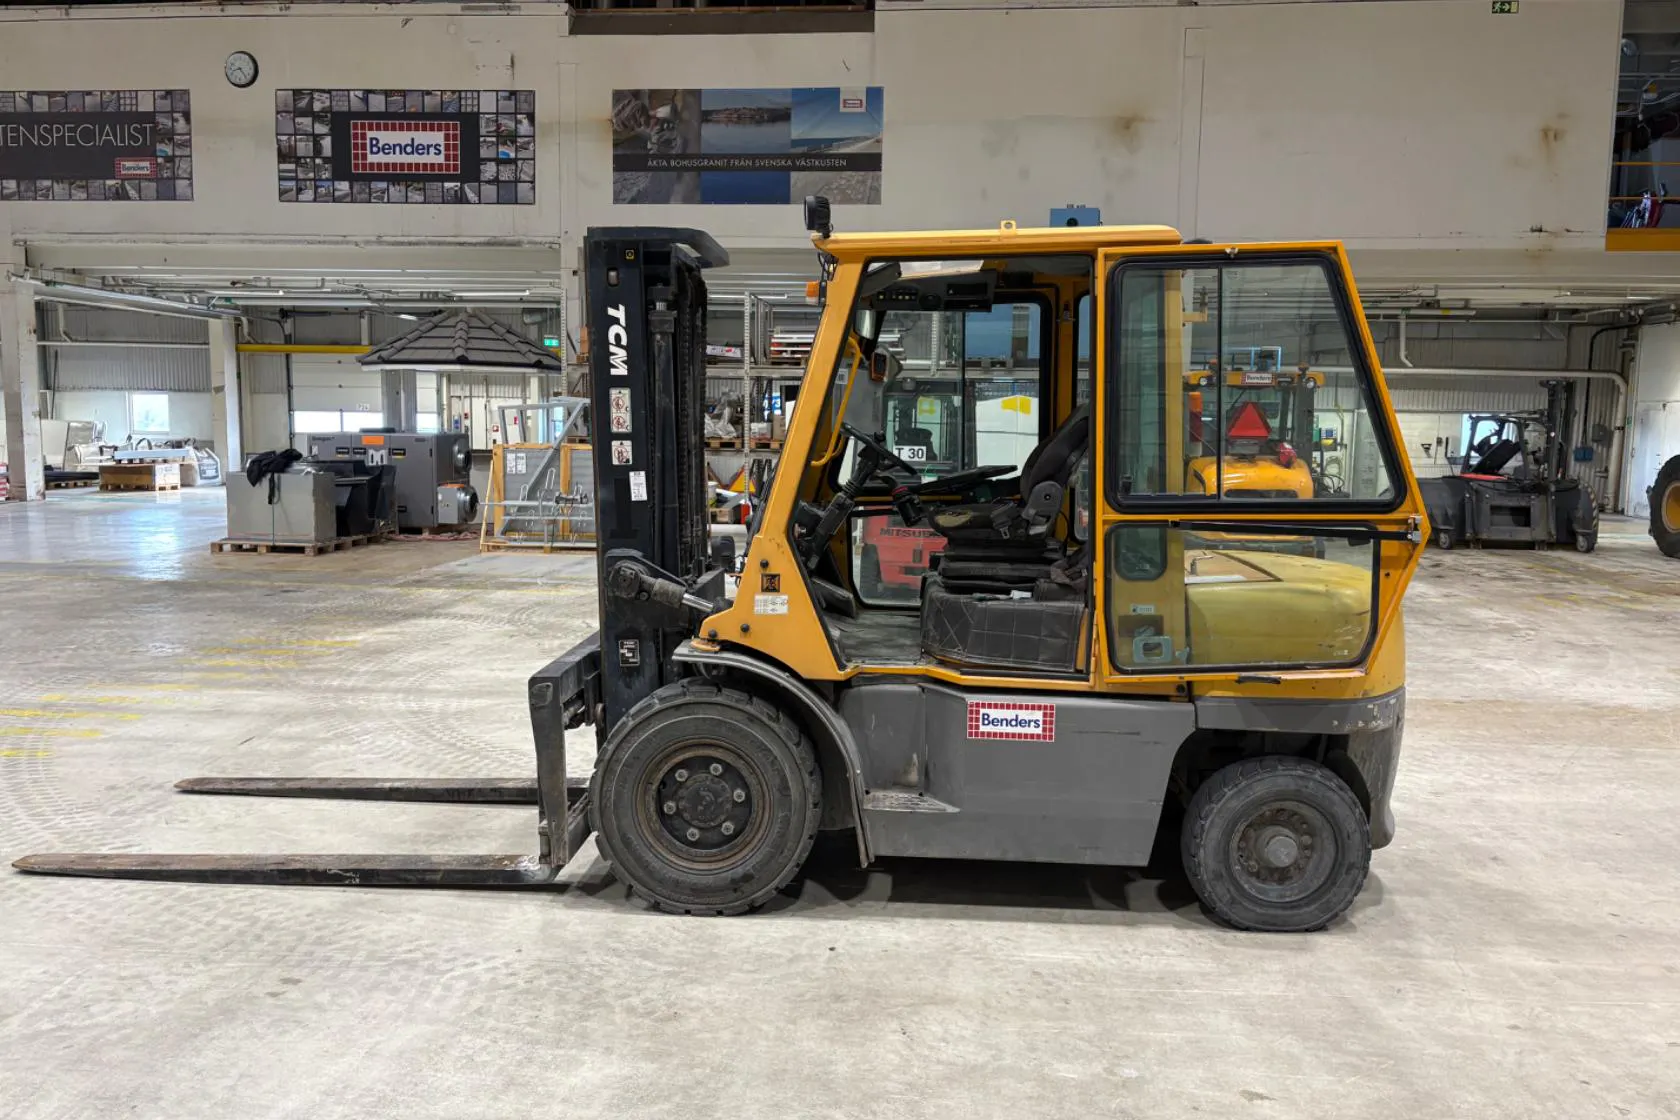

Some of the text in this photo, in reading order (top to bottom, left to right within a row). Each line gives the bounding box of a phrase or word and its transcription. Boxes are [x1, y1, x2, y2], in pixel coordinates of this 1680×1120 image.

[369, 136, 442, 156] Benders
[755, 158, 792, 167] SVENSKA
[795, 157, 847, 167] VÄSTKUSTEN
[607, 303, 628, 376] TCM
[895, 447, 924, 459] T 30
[982, 713, 1041, 728] Benders
